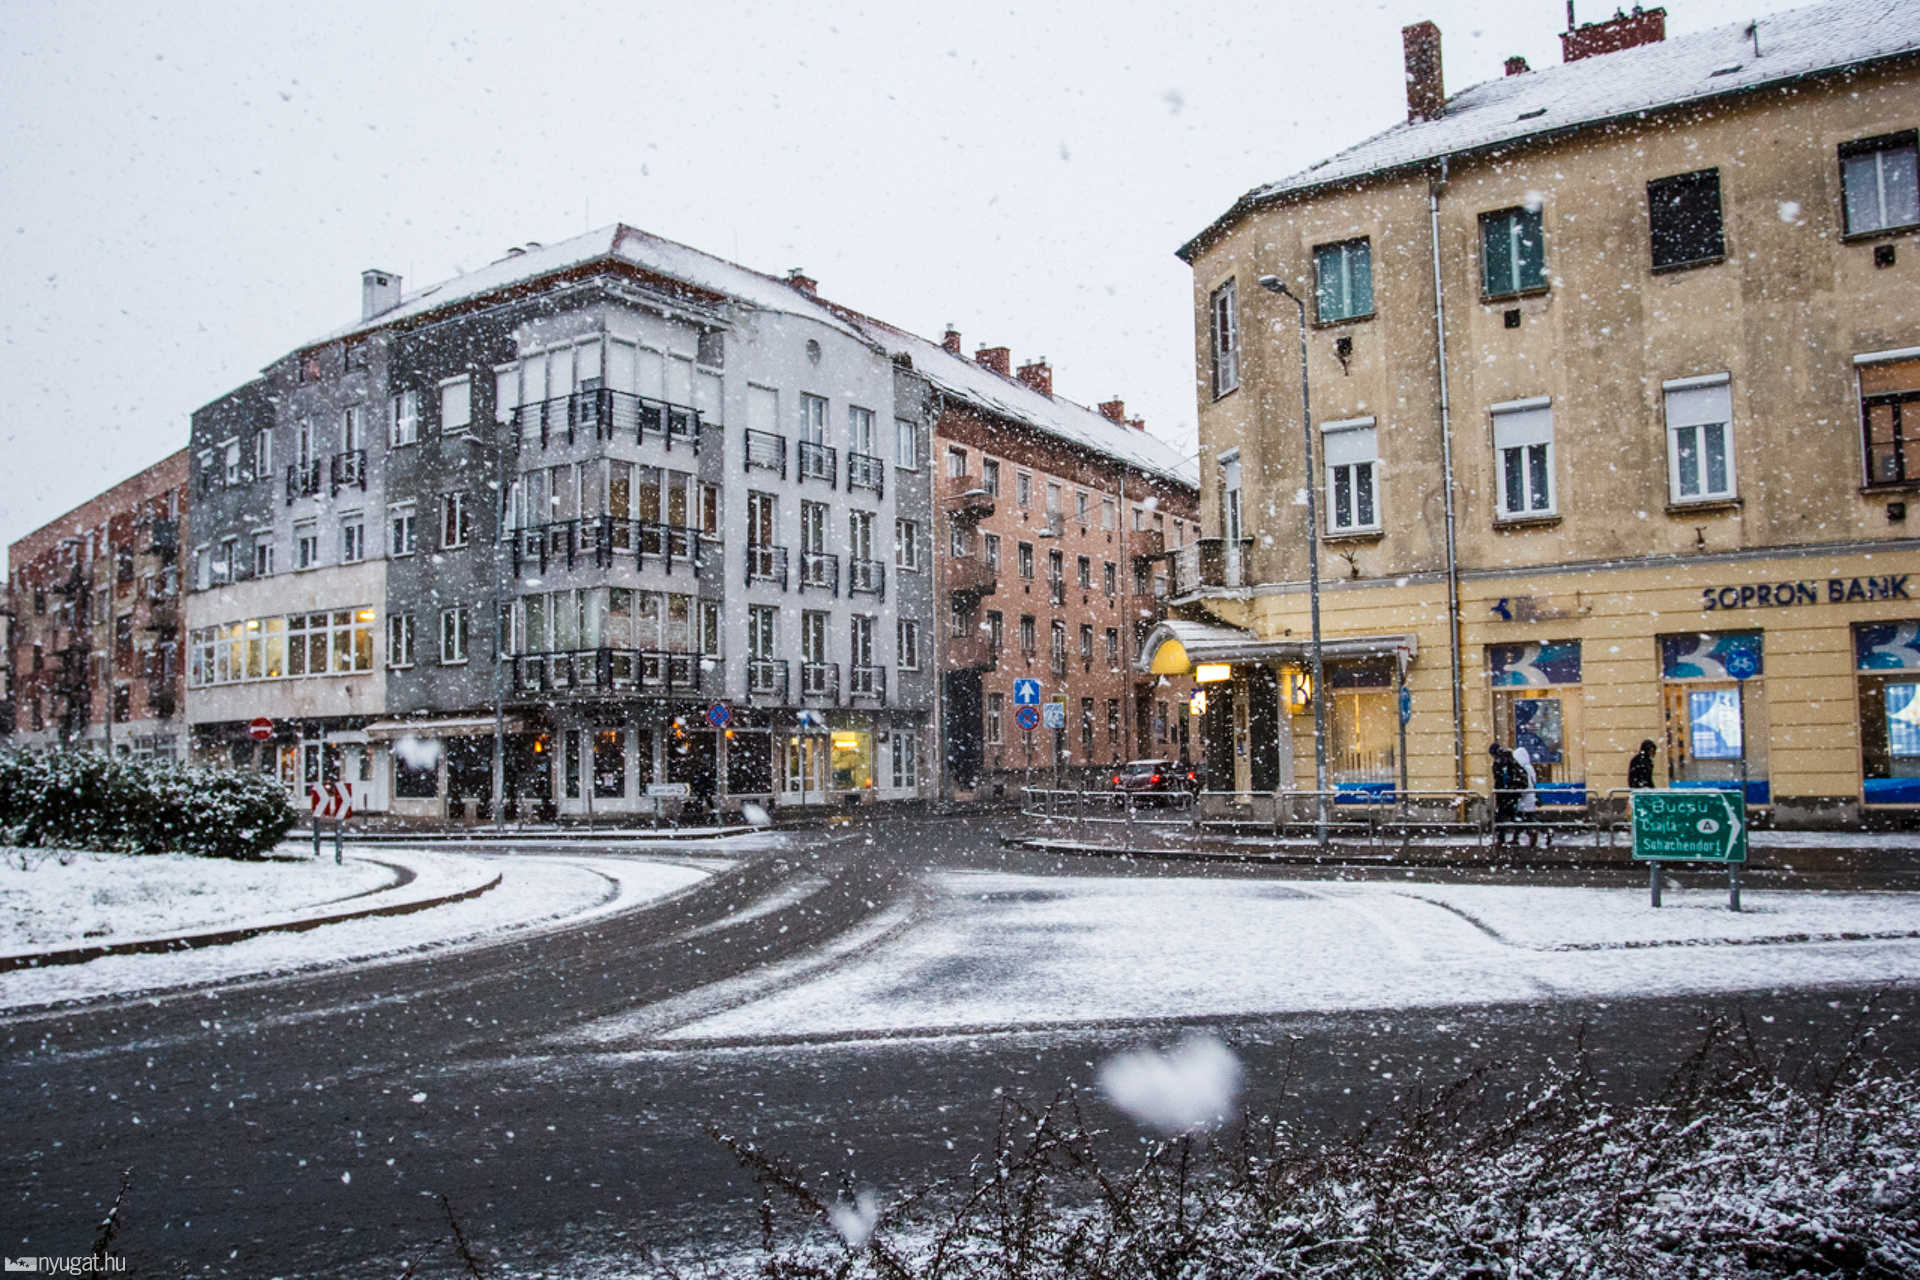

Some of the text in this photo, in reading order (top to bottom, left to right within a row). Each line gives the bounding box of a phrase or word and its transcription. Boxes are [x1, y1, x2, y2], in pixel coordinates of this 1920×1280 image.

[1703, 574, 1909, 611] SOPRON BANK
[1652, 799, 1708, 813] Bucsu
[1643, 838, 1721, 852] Schachendorf
